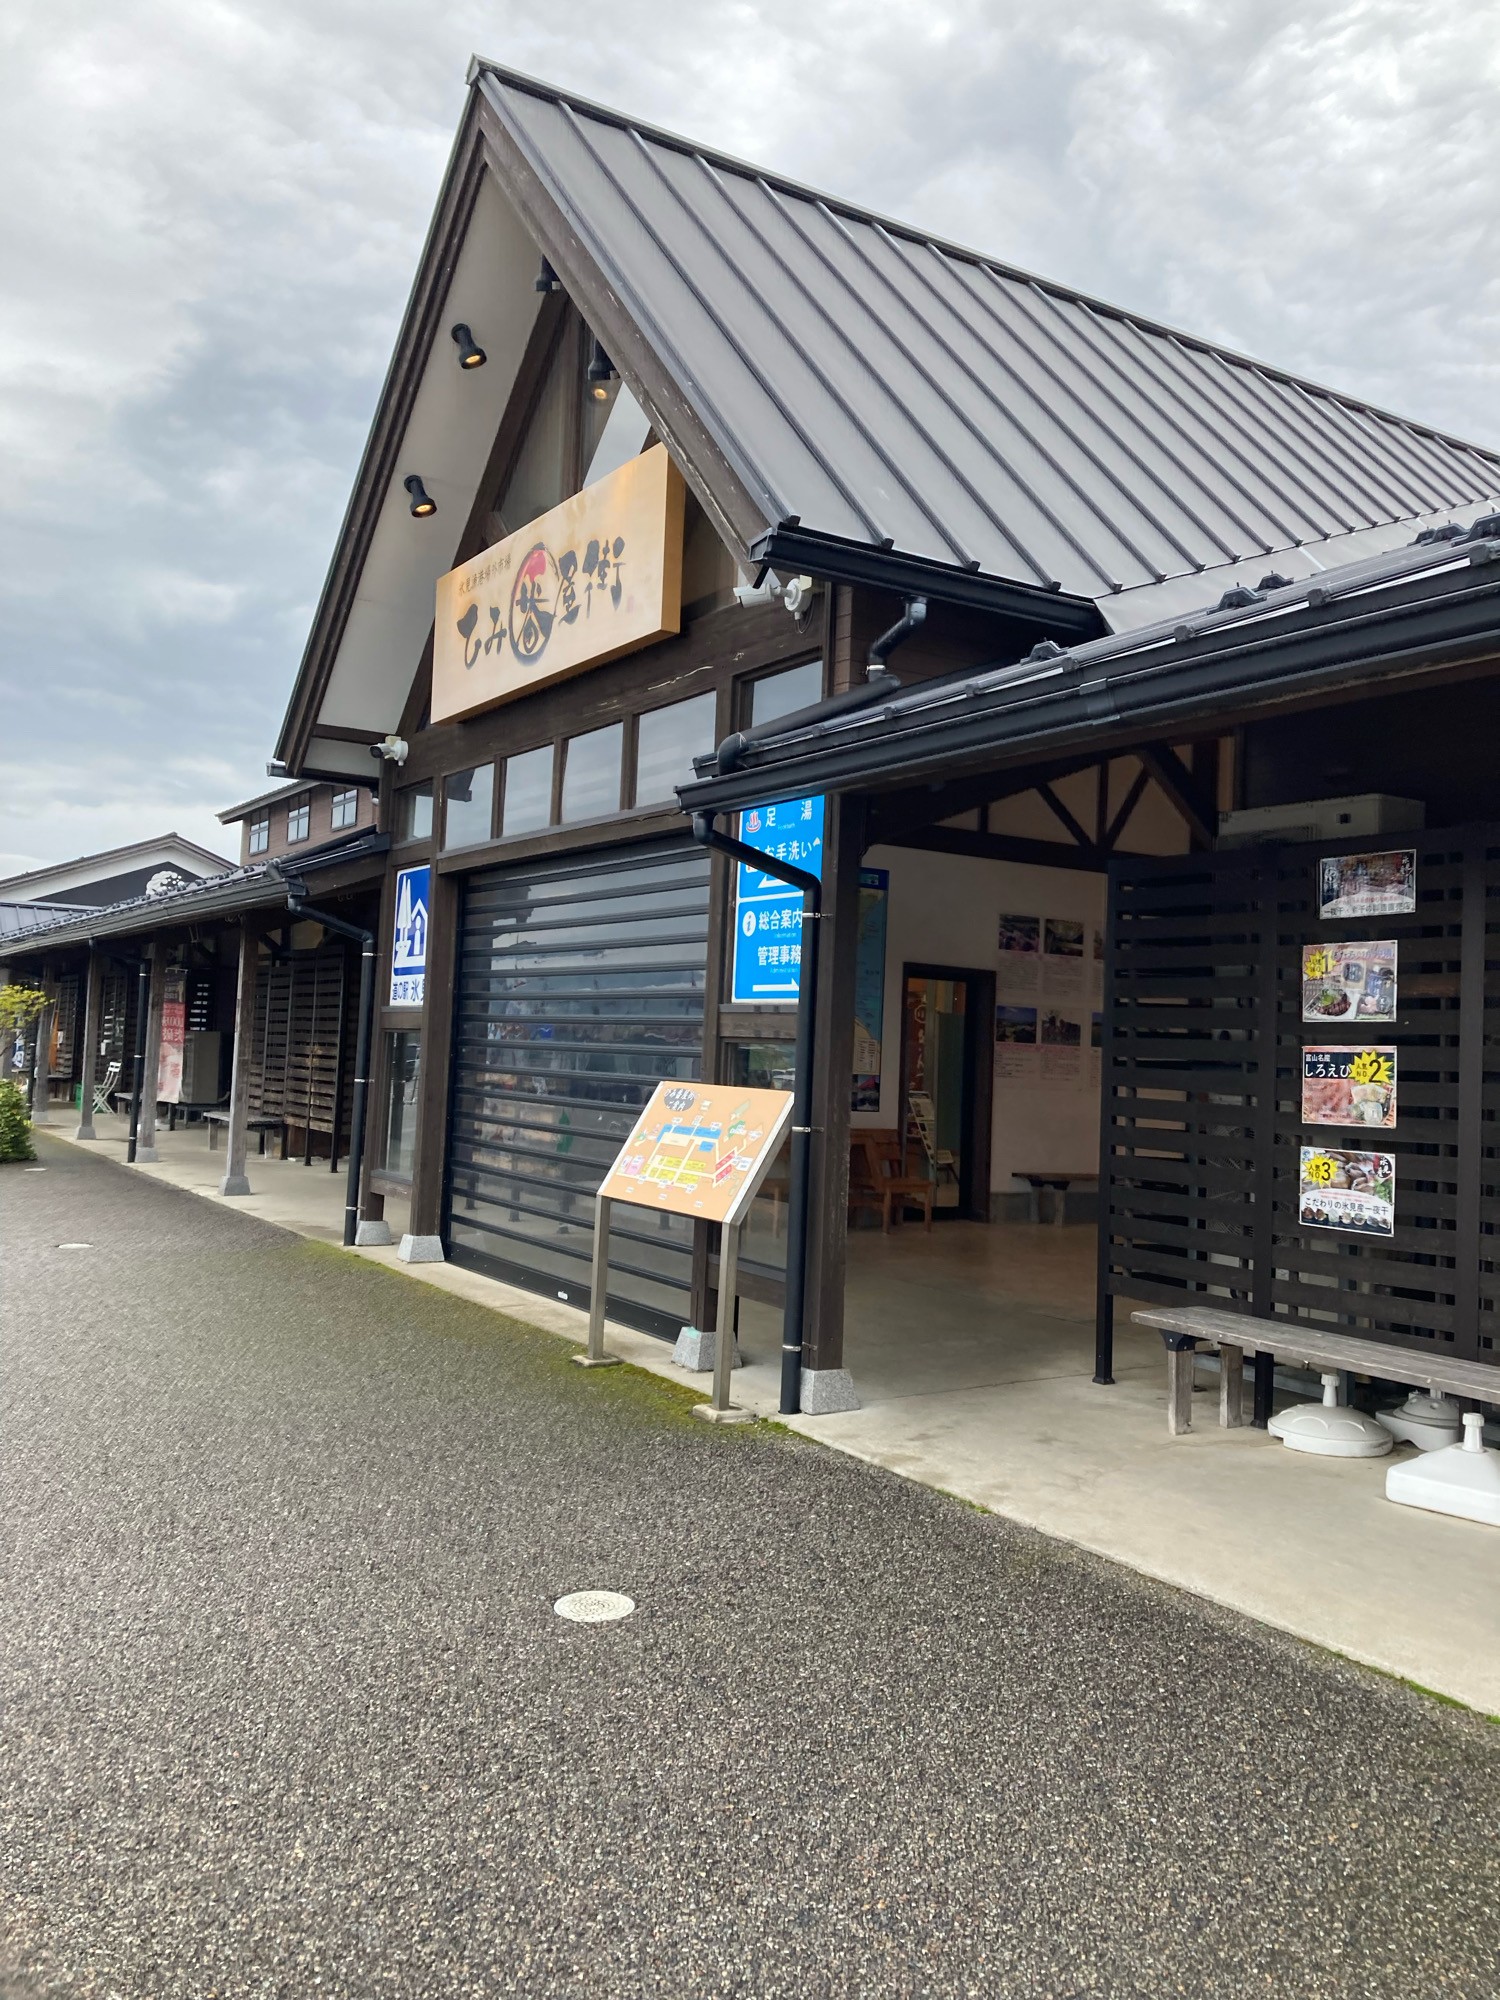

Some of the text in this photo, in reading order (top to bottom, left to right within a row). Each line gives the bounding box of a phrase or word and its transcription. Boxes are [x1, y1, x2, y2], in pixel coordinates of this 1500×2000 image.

[457, 536, 626, 670] ひみ番屋街
[758, 908, 803, 931] 総合案内
[1305, 1054, 1331, 1062] 富山名産
[1369, 1059, 1382, 1083] 2
[1321, 1161, 1331, 1181] 3
[1305, 1197, 1390, 1216] こだわりの氷見産一夜干
